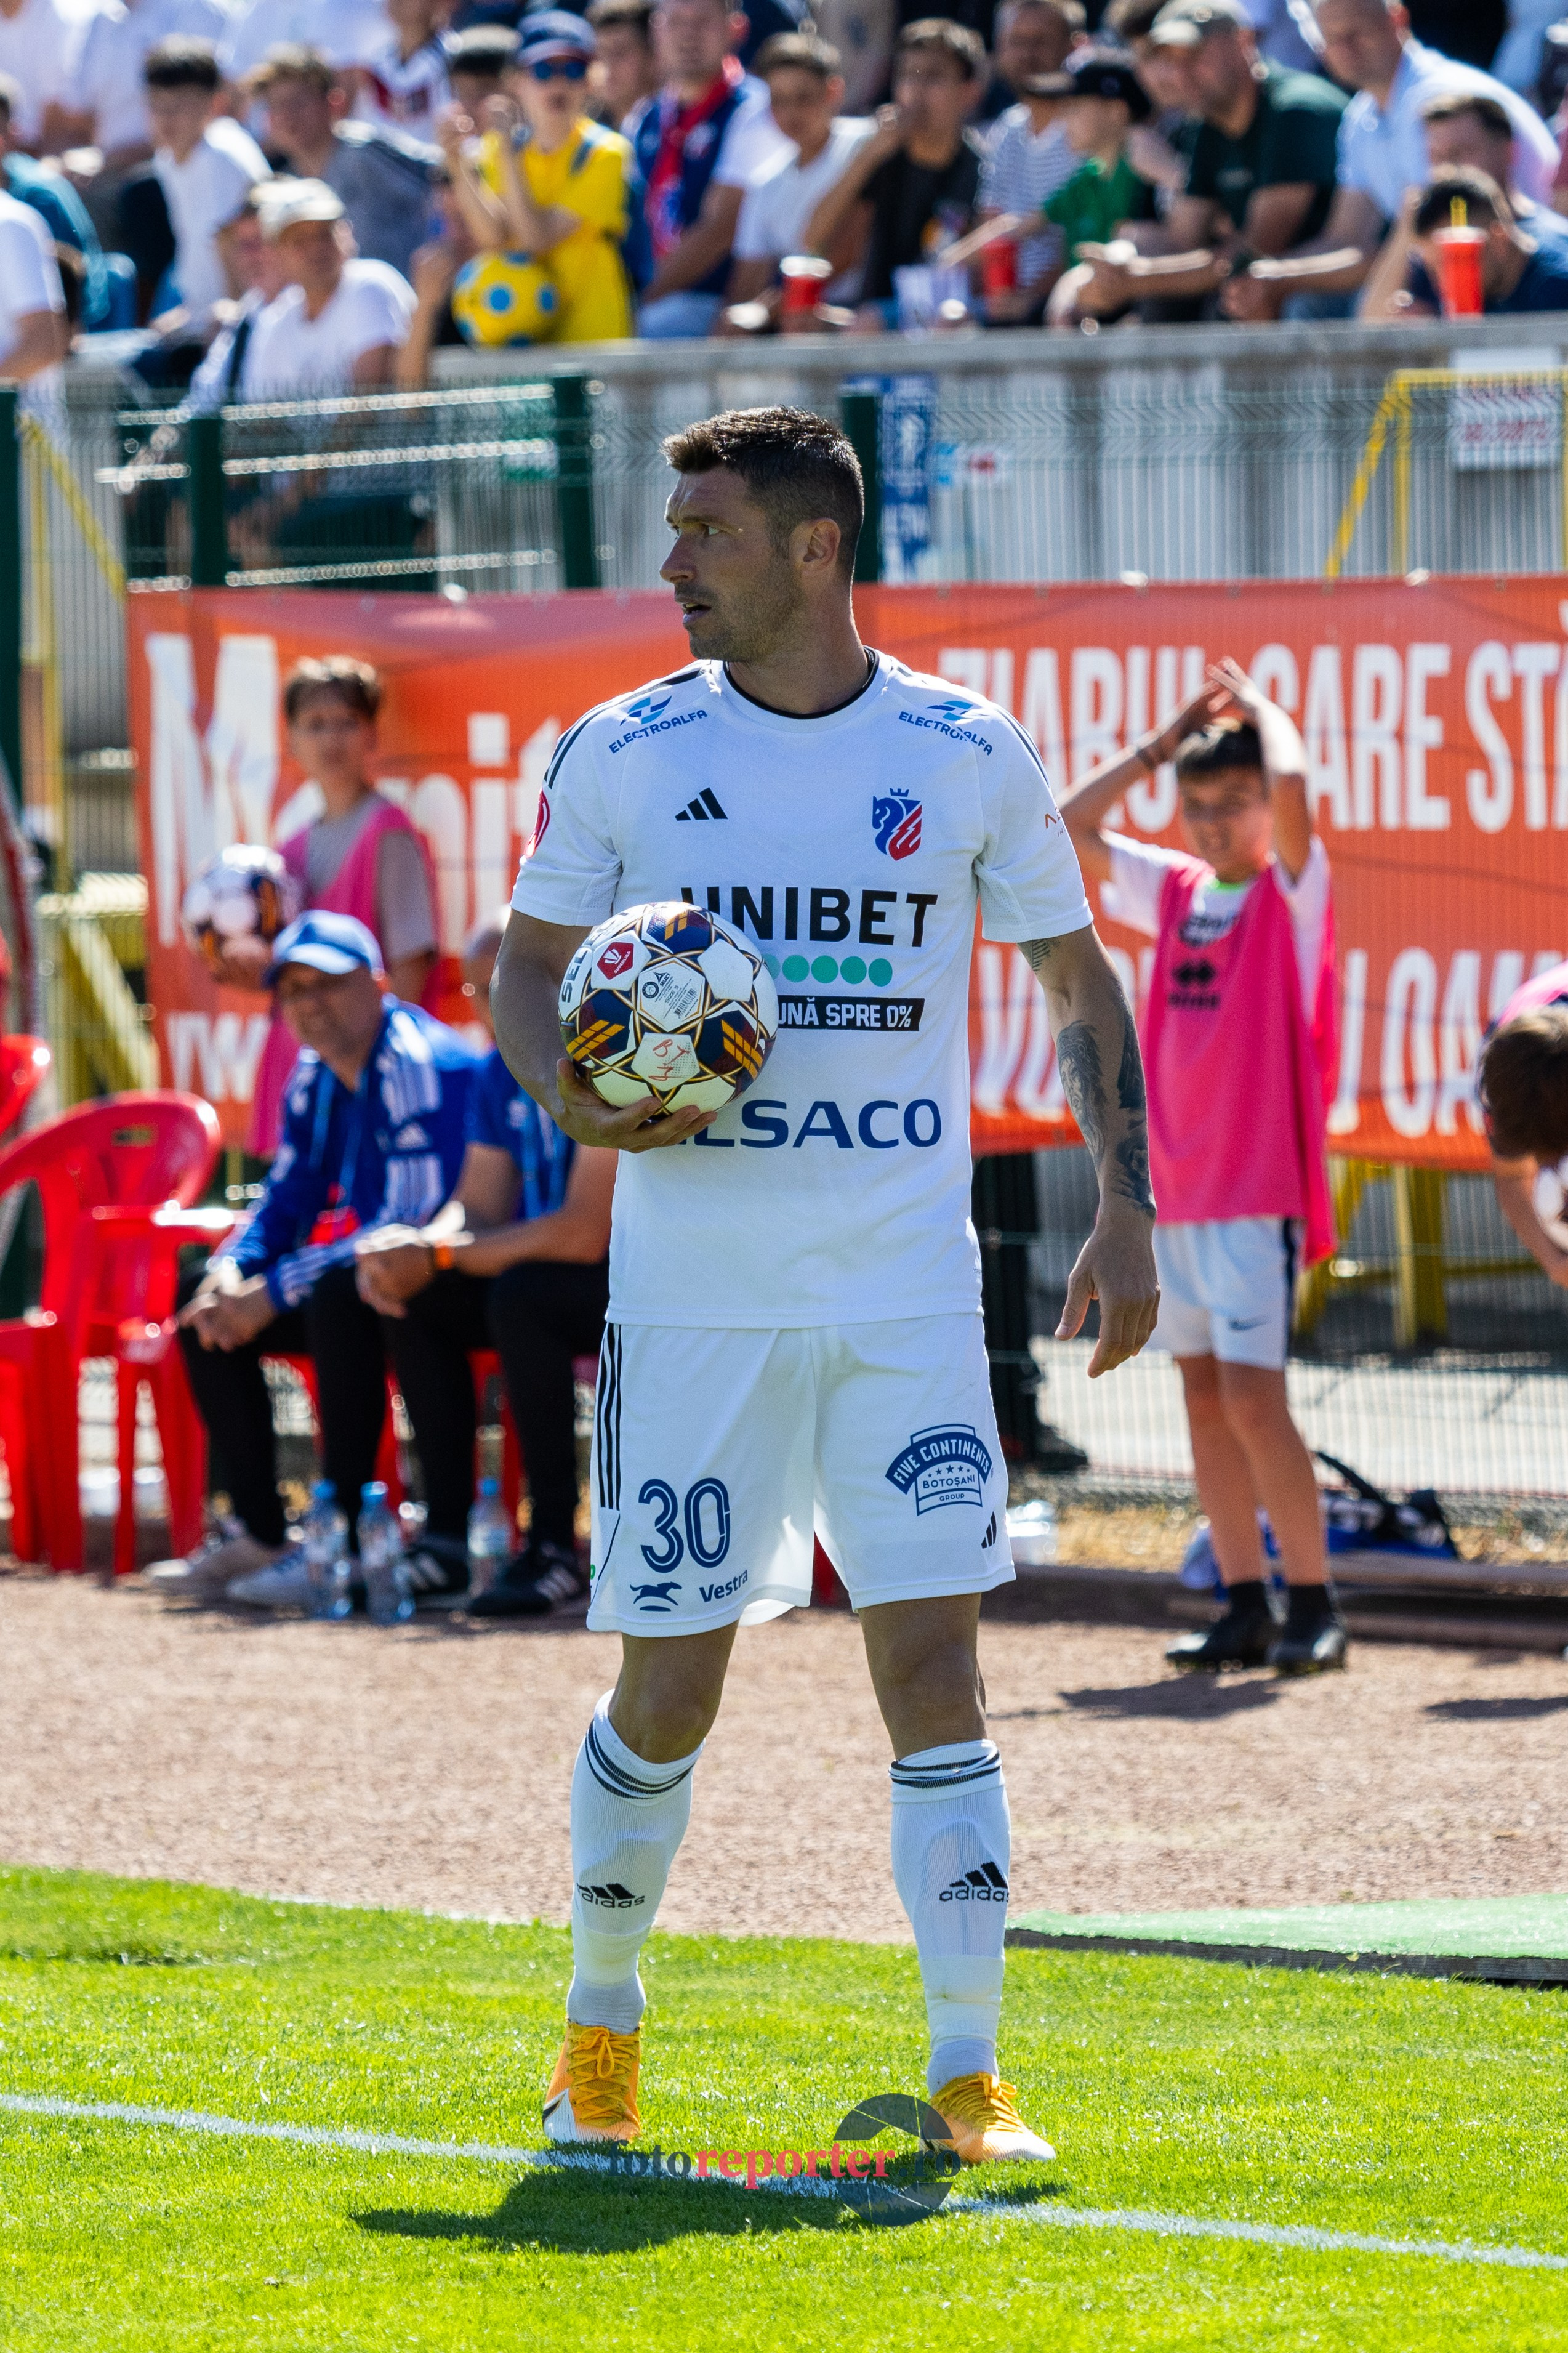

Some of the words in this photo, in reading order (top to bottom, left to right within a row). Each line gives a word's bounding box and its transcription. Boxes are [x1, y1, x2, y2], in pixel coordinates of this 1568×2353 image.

[608, 710, 707, 754] ELECTROALFA
[898, 711, 993, 756] ELECTROALFA
[614, 951, 630, 974] SUPERLIGA
[826, 1004, 881, 1027] SPRE
[886, 1005, 913, 1028] 0%
[678, 1099, 941, 1148] LSACO
[893, 1454, 920, 1485] FIVE
[920, 1439, 989, 1473] CONTINENTS
[923, 1475, 975, 1488] BOTOȘANI
[939, 1493, 965, 1501] GROUP
[638, 1477, 730, 1573] 30
[699, 1569, 748, 1602] Vestra
[577, 1888, 645, 1908] didas
